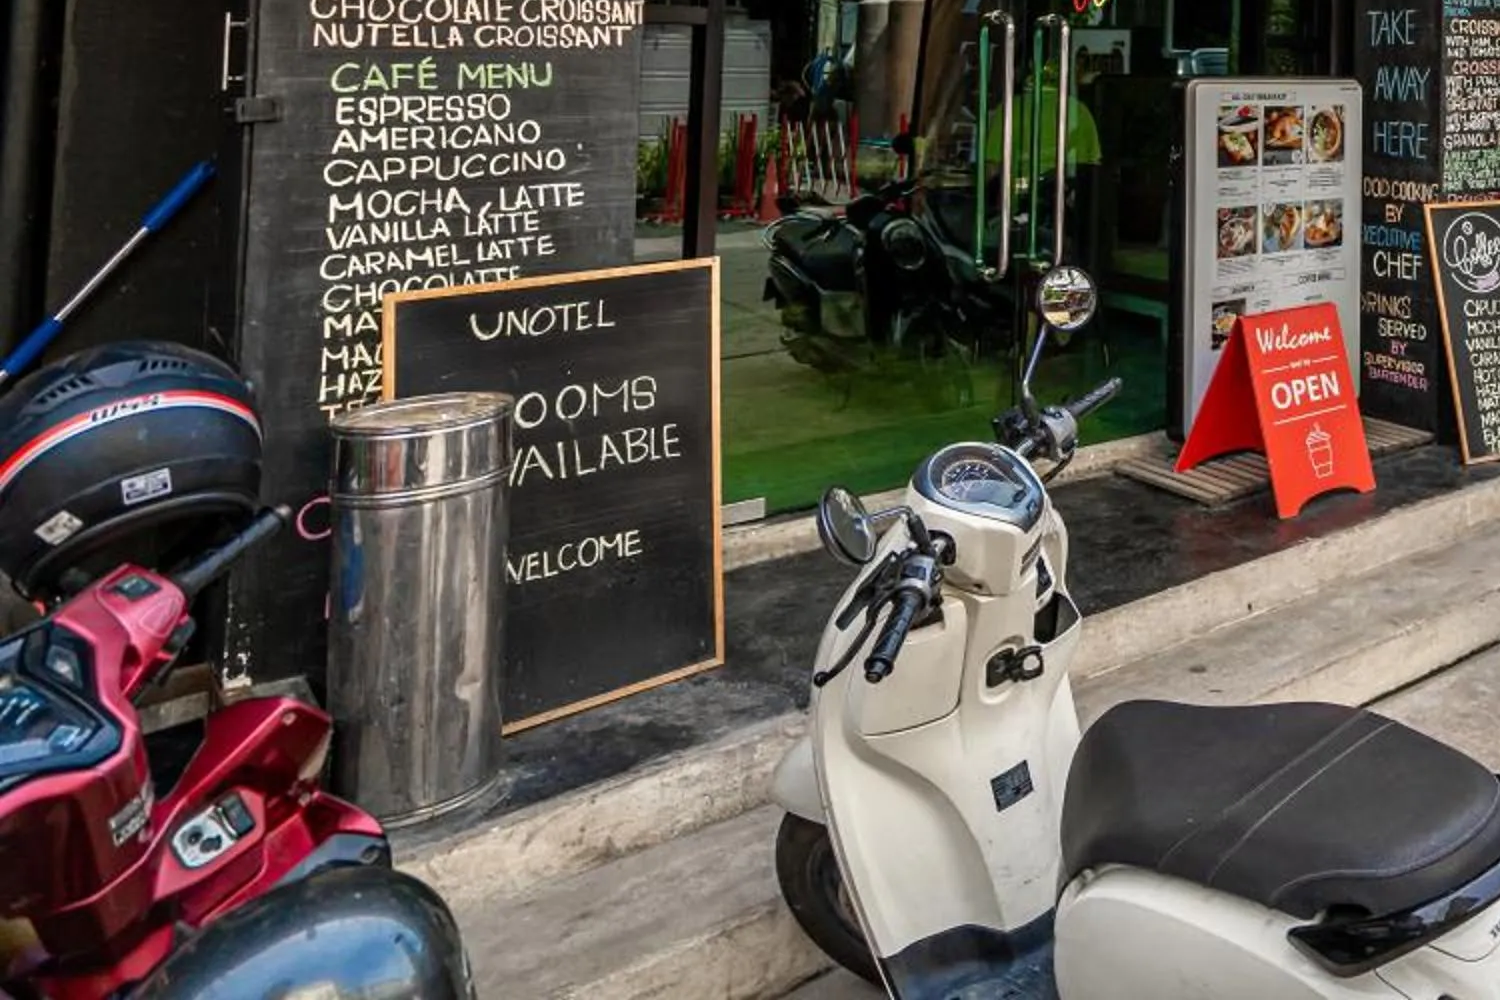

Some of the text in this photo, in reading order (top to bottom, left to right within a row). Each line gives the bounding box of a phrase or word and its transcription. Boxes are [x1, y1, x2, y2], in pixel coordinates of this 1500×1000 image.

[313, 22, 633, 50] NUTELLA CROISSANT
[1367, 9, 1417, 47] TAKE
[330, 56, 553, 94] CAFÉ MENU
[1374, 65, 1431, 103] AWAY
[336, 93, 511, 127] ESPRESSO
[331, 119, 542, 154] AMERICANO
[1373, 121, 1430, 160] HERE
[1443, 132, 1497, 150] GRANOLA
[323, 148, 567, 187] CAPPUCCINO
[499, 182, 586, 212] LATTE
[1385, 203, 1404, 223] BY
[326, 210, 540, 250] VANILLA LATTE
[1363, 225, 1421, 251] XECUTIVE
[320, 235, 556, 281] CARAMEL LATTE
[1373, 250, 1423, 280] CHEF
[471, 299, 616, 341] UNOTEL
[1378, 317, 1427, 341] SERVED
[1255, 323, 1332, 354] Welcome
[1391, 340, 1408, 356] BY
[1271, 370, 1341, 410] OPEN
[1369, 366, 1428, 393] BARTENDER
[1473, 367, 1497, 384] HOT
[514, 375, 657, 429] OOMS
[509, 423, 682, 487] AILABLE
